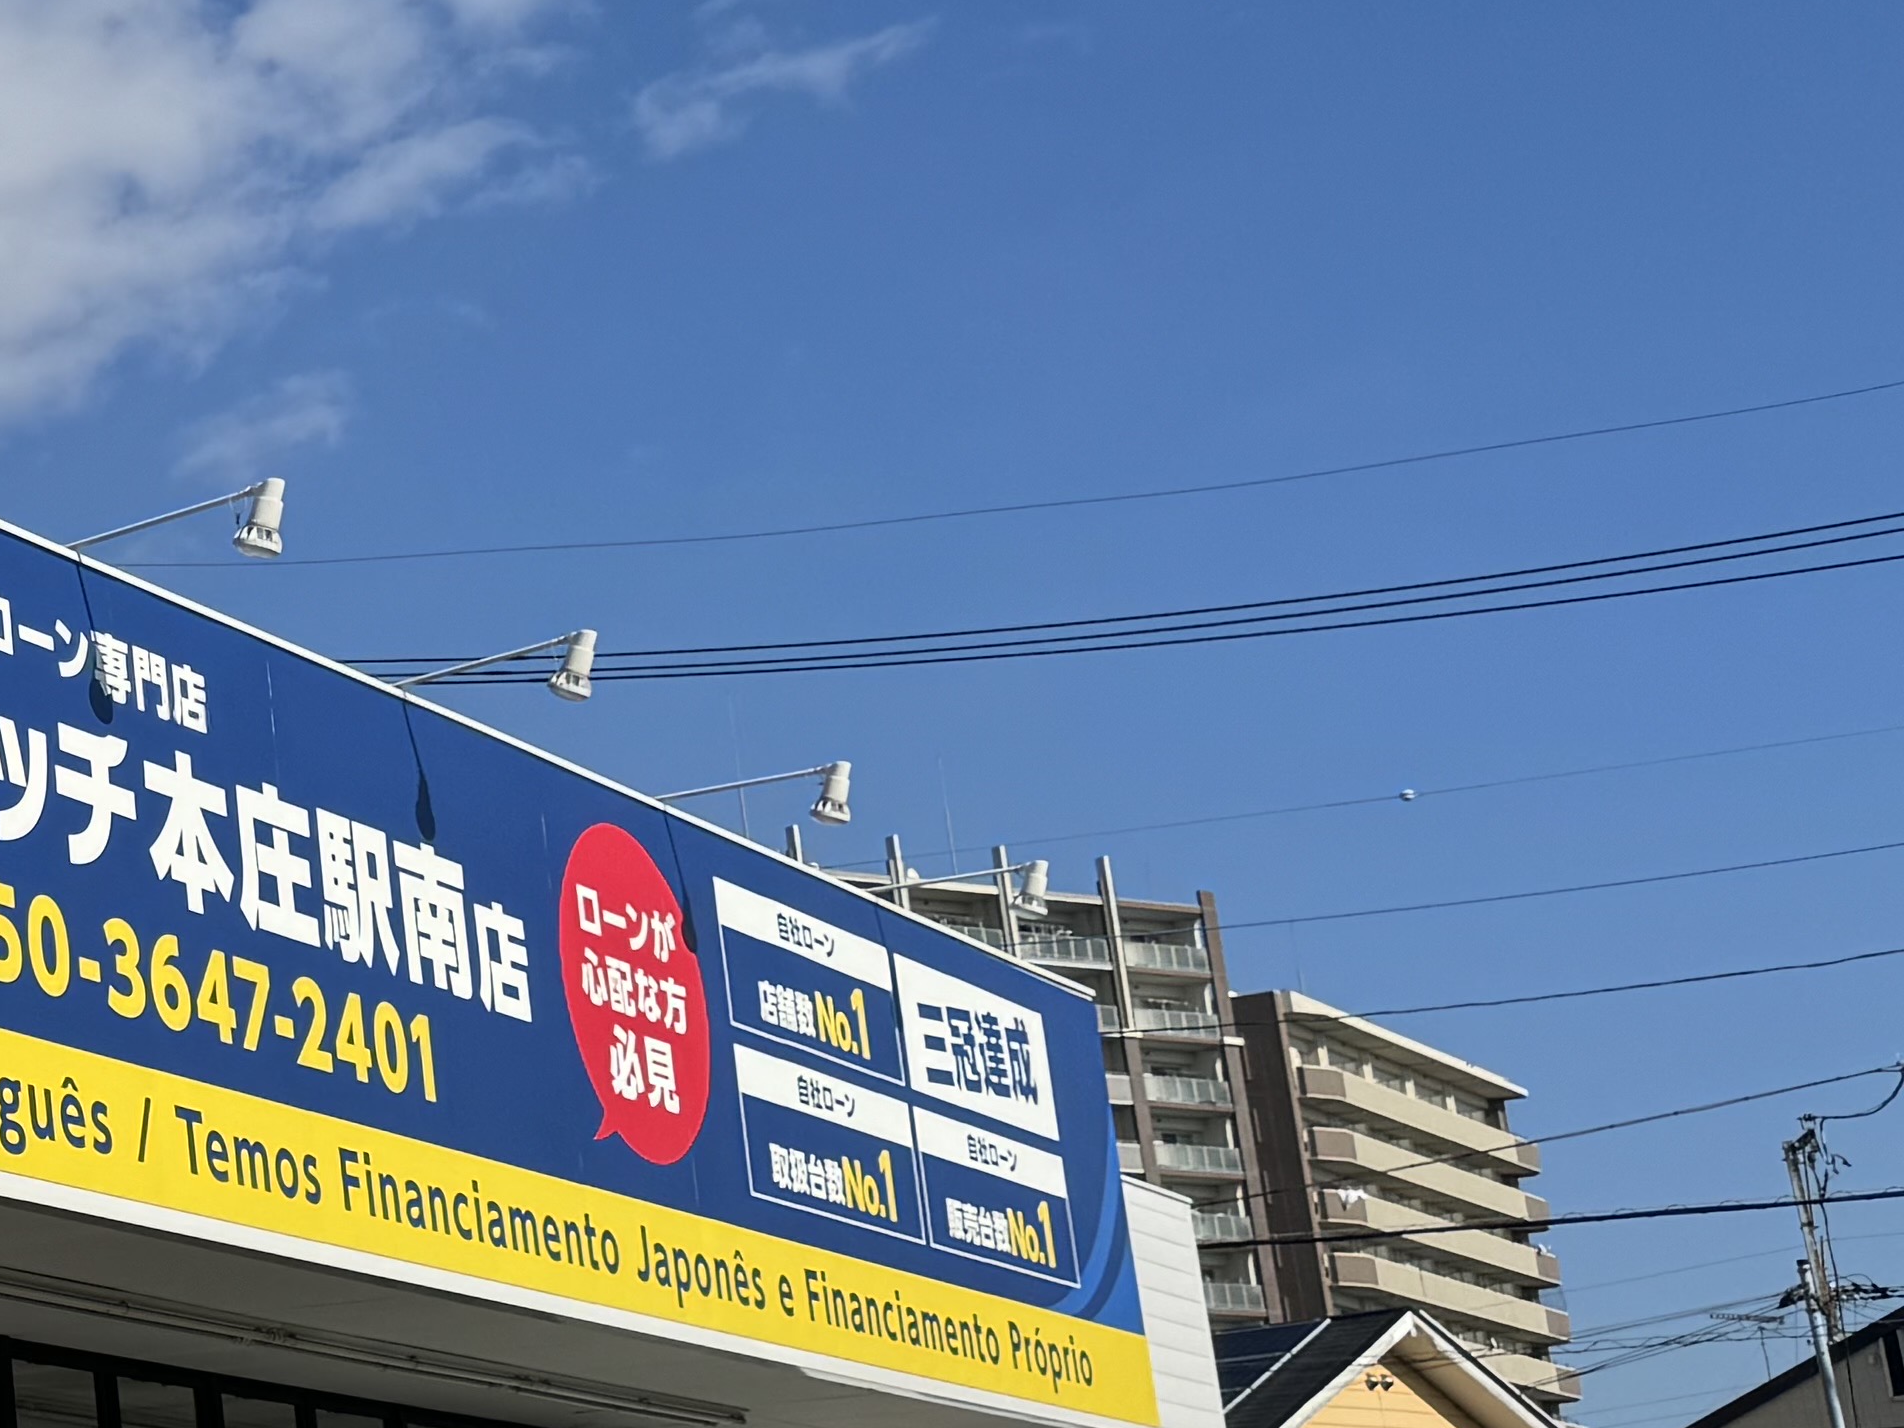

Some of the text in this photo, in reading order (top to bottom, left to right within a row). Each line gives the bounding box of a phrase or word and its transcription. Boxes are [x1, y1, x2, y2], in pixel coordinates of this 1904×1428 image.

[576, 883, 677, 962] ローンが
[777, 913, 835, 958] 自社ローン
[582, 947, 687, 1035] 心配な方
[609, 1024, 681, 1114] 必見
[916, 1002, 1039, 1105] 三冠達成
[797, 1075, 856, 1117] 自社ローン
[967, 1133, 1019, 1172] 自社ローン
[174, 1104, 322, 1205] Temos
[339, 1146, 620, 1278] Financiamento
[637, 1223, 765, 1314] Japonês
[778, 1277, 796, 1319] e
[805, 1269, 1000, 1368] Financiamento
[1008, 1309, 1094, 1390] Próprio
